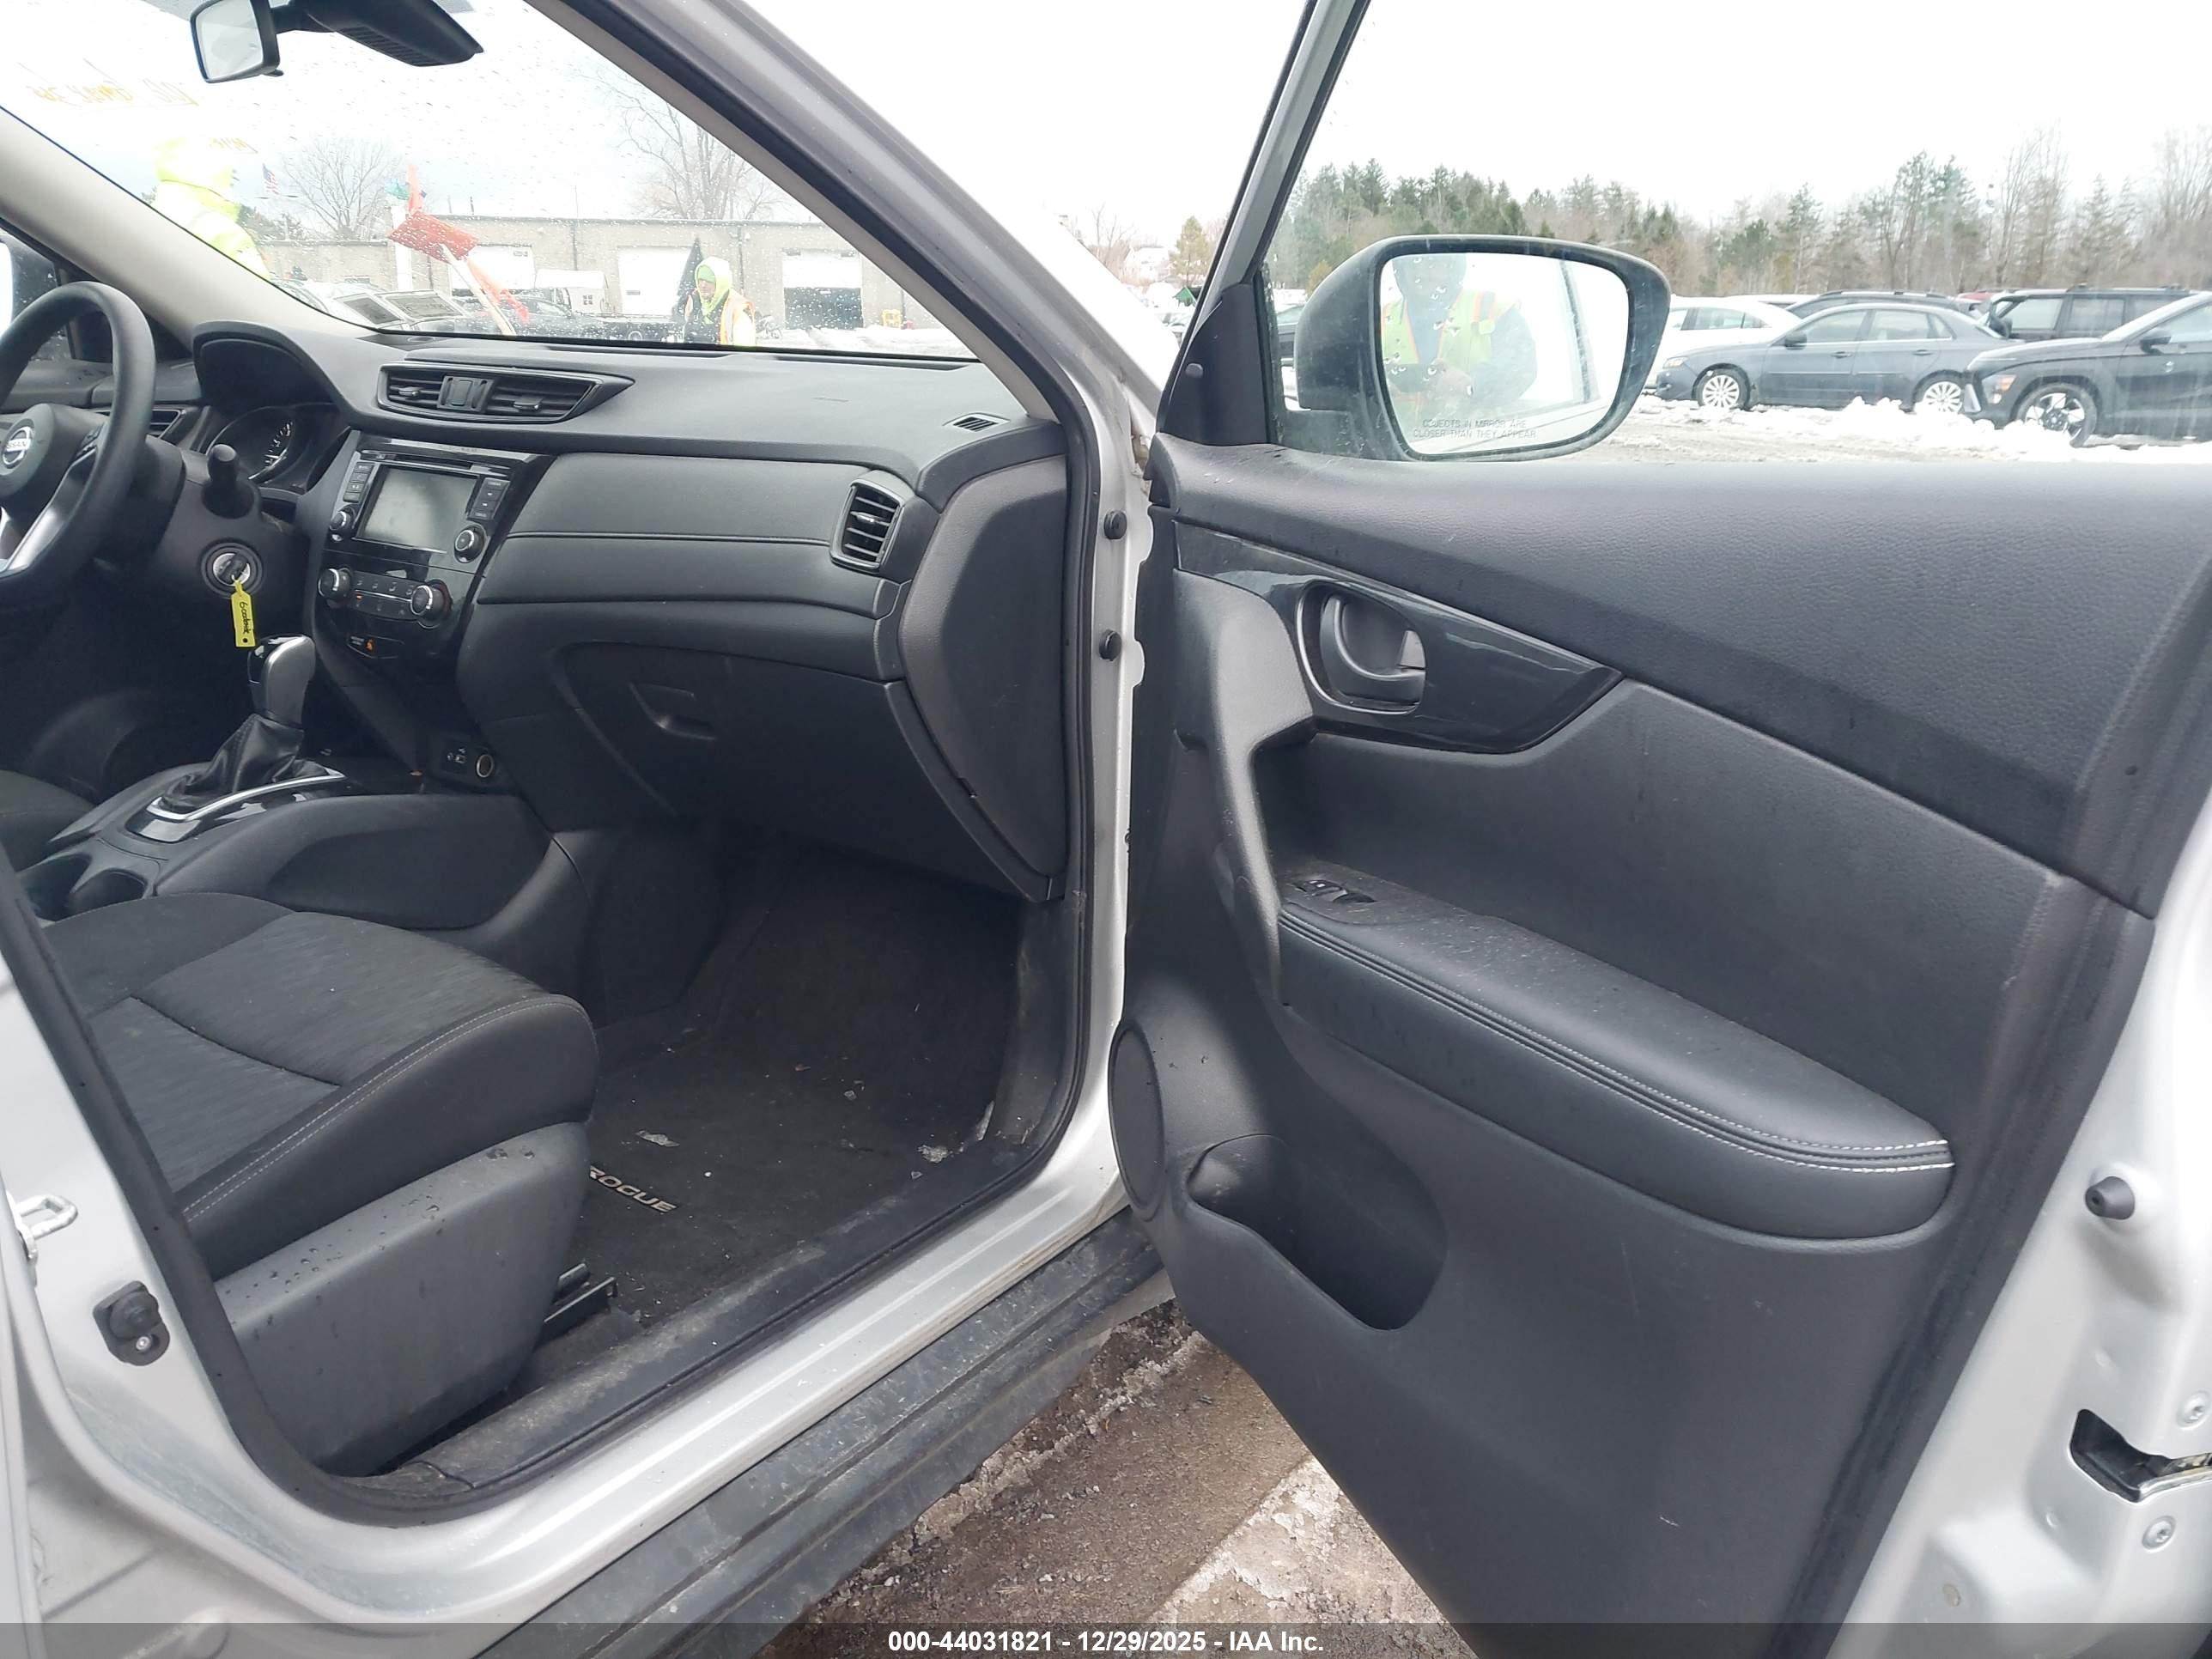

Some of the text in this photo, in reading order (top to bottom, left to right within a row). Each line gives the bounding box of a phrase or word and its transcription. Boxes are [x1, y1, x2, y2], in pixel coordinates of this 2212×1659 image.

[1422, 418, 1461, 428] OBJECTS
[1474, 419, 1505, 428] MIRROR
[1510, 420, 1527, 429] ARE
[1413, 428, 1536, 440] CLOSER THAN THEY APPEAR
